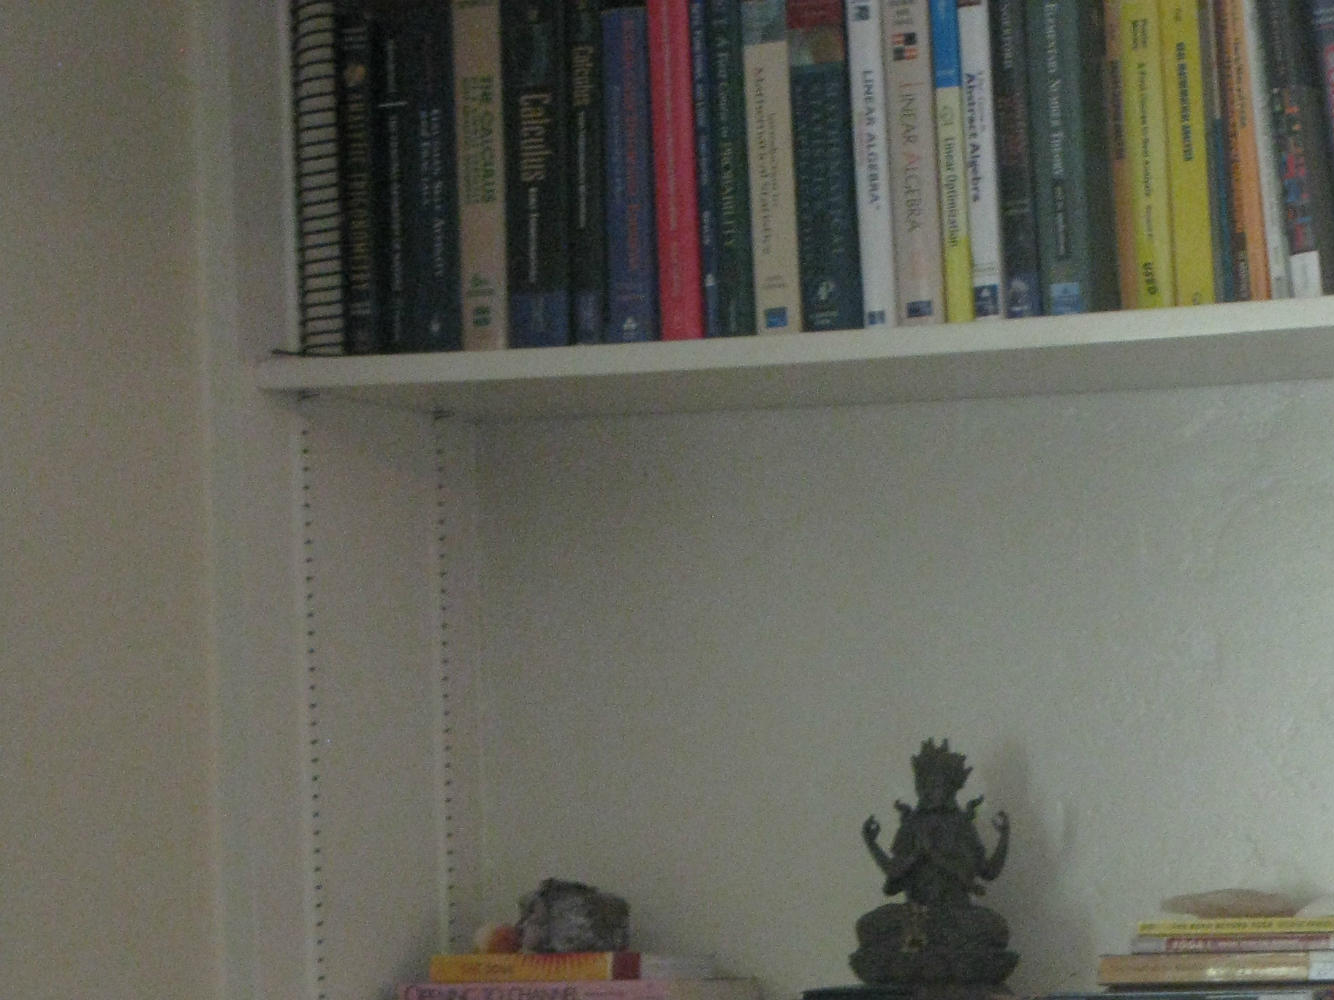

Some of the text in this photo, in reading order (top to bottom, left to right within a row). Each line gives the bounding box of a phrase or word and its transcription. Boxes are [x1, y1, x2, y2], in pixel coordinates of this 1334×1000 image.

[518, 93, 553, 184] Calculus
[861, 70, 881, 205] LINEAR ALGEBRA
[899, 82, 926, 233] LINEAR ALGEBRA
[943, 136, 963, 248] Linear Optimization
[966, 144, 985, 203] Algebra
